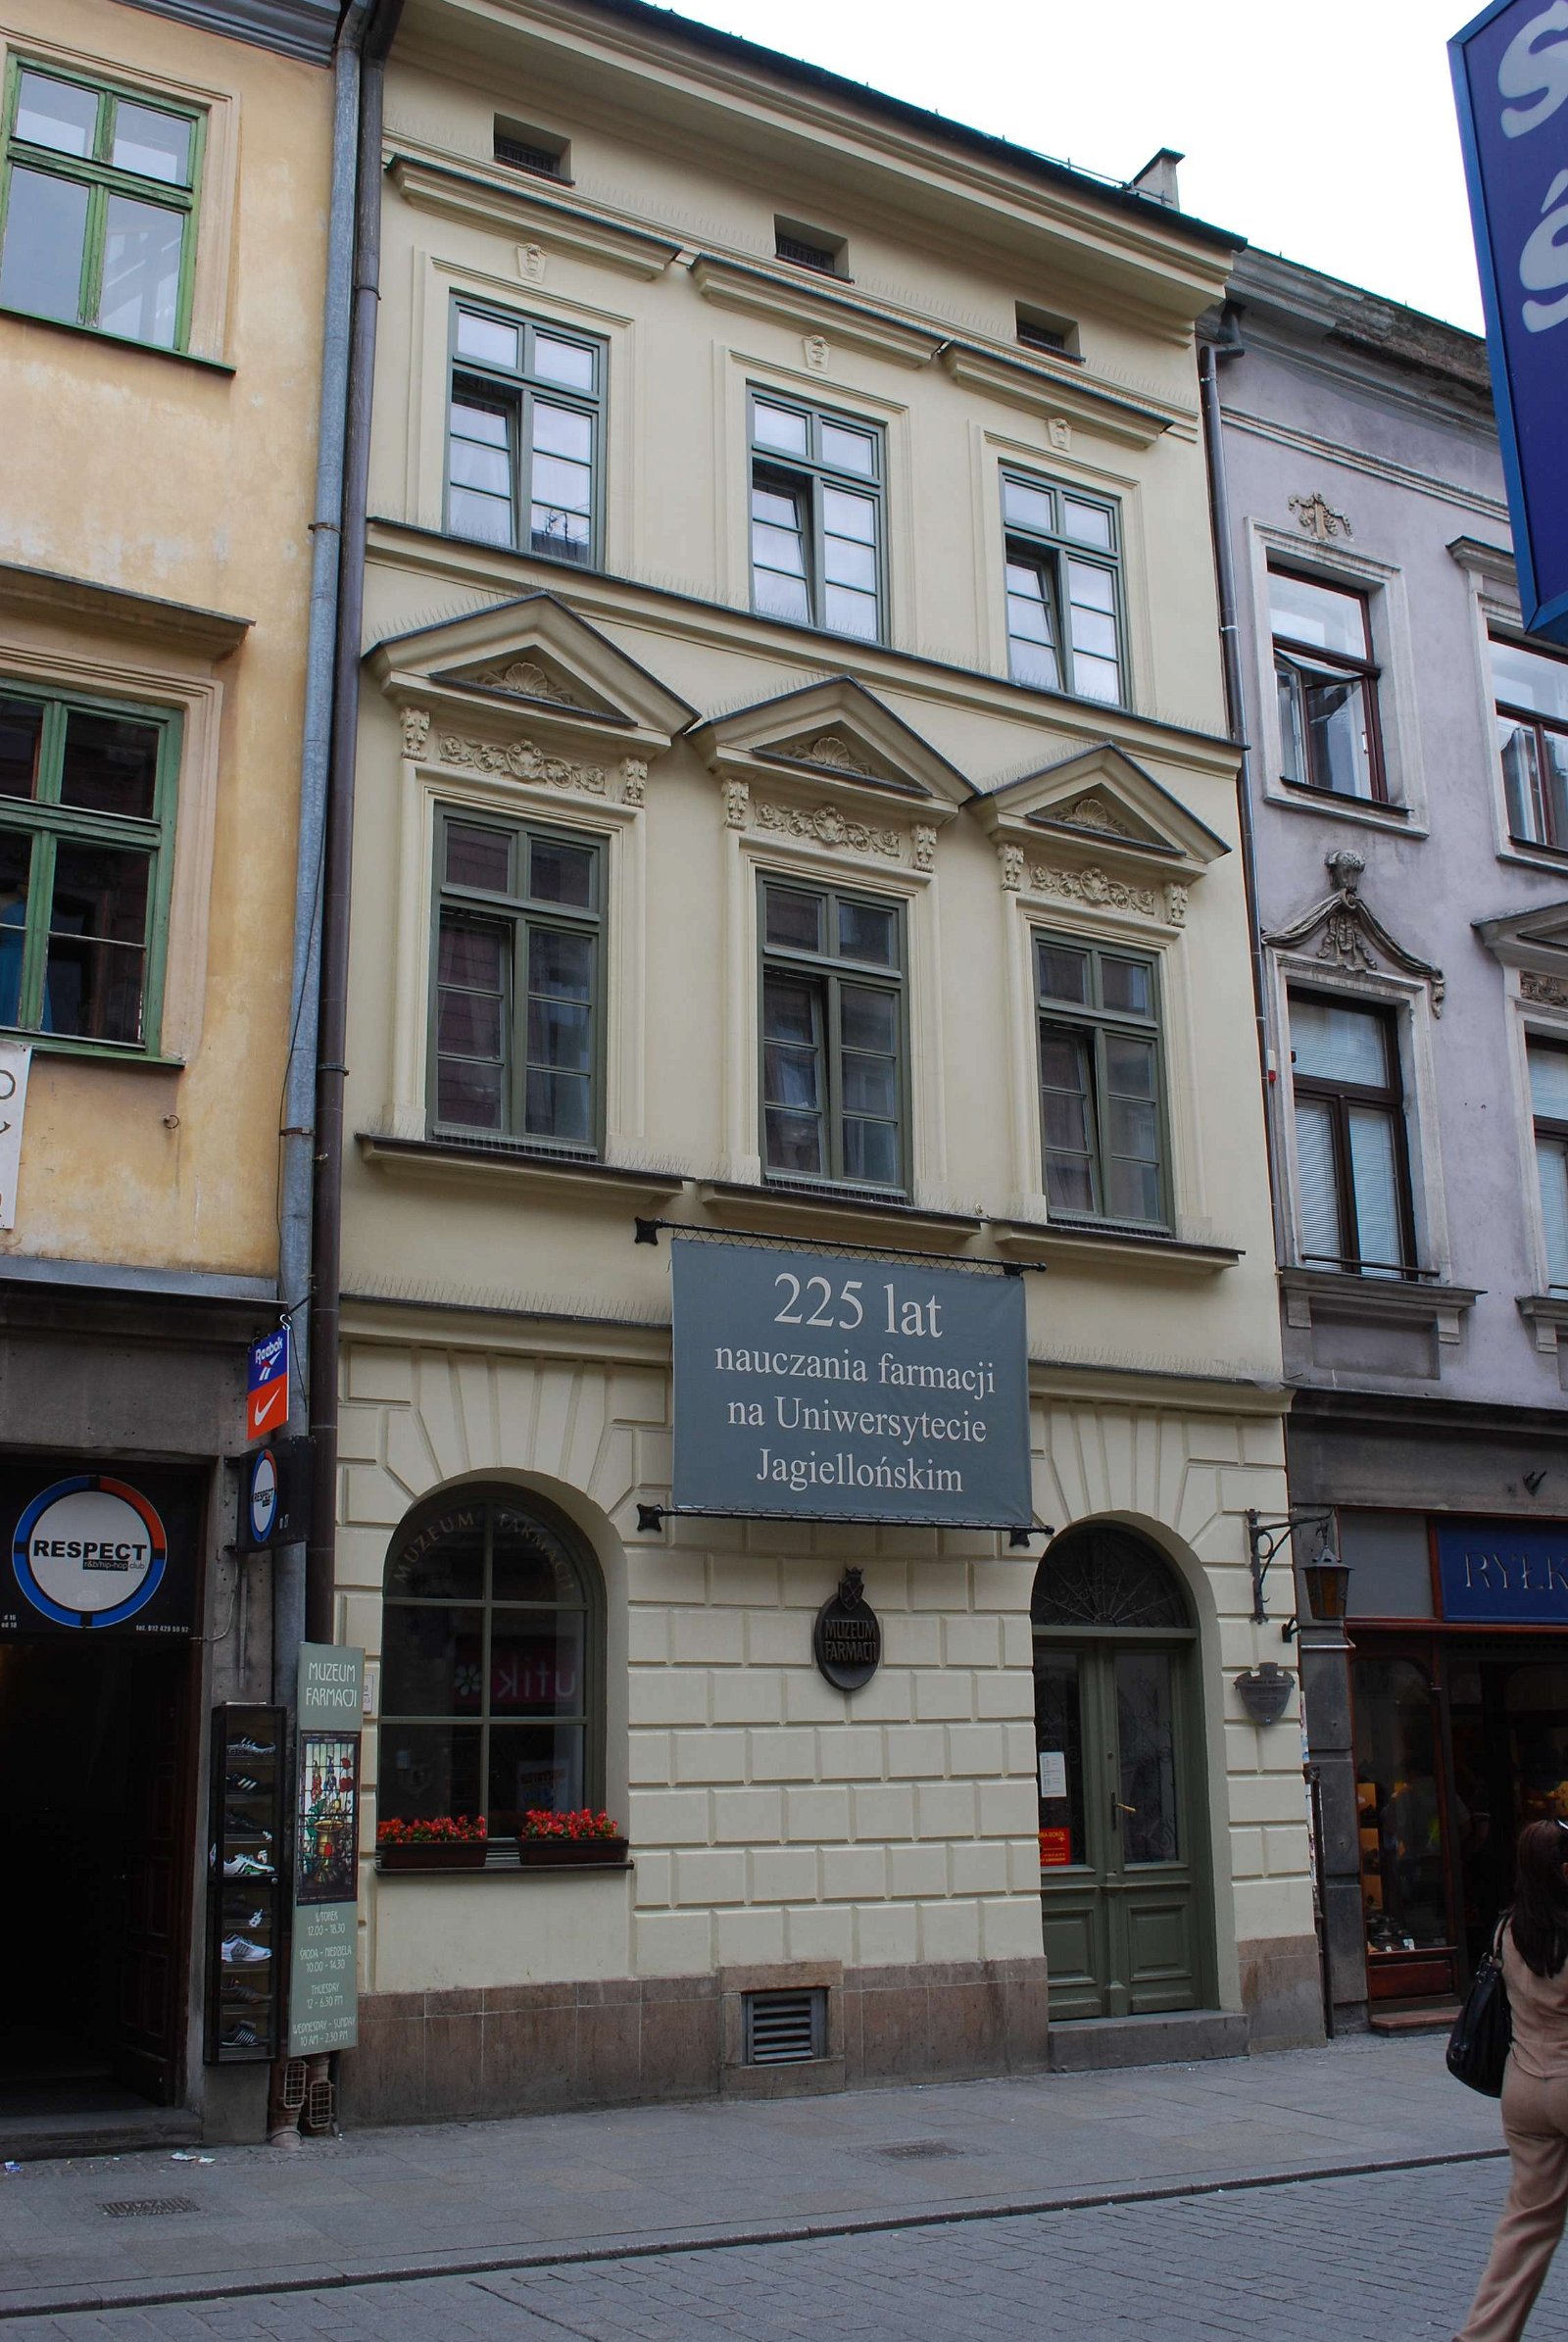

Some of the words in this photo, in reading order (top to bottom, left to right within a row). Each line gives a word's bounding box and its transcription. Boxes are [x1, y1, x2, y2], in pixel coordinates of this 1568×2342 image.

[773, 1272, 864, 1331] 225
[883, 1283, 943, 1339] lat
[714, 1346, 868, 1383] nauczania
[878, 1353, 996, 1400] farmacji
[727, 1399, 765, 1428] na
[774, 1395, 988, 1445] Uniwersytecie
[757, 1448, 963, 1492] Jagiellońskim
[32, 1538, 148, 1562] RESPECT
[393, 1512, 475, 1585] MUZEUM
[824, 1620, 875, 1639] MUZEUM
[823, 1641, 877, 1662] FARMACJI
[309, 1662, 356, 1683] MUZEUM
[306, 1687, 357, 1707] FARMACJI
[306, 1998, 314, 2009] 12
[292, 2020, 327, 2034] WEDNESDAY
[333, 2016, 356, 2029] SUNDAY
[300, 2035, 308, 2047] 10
